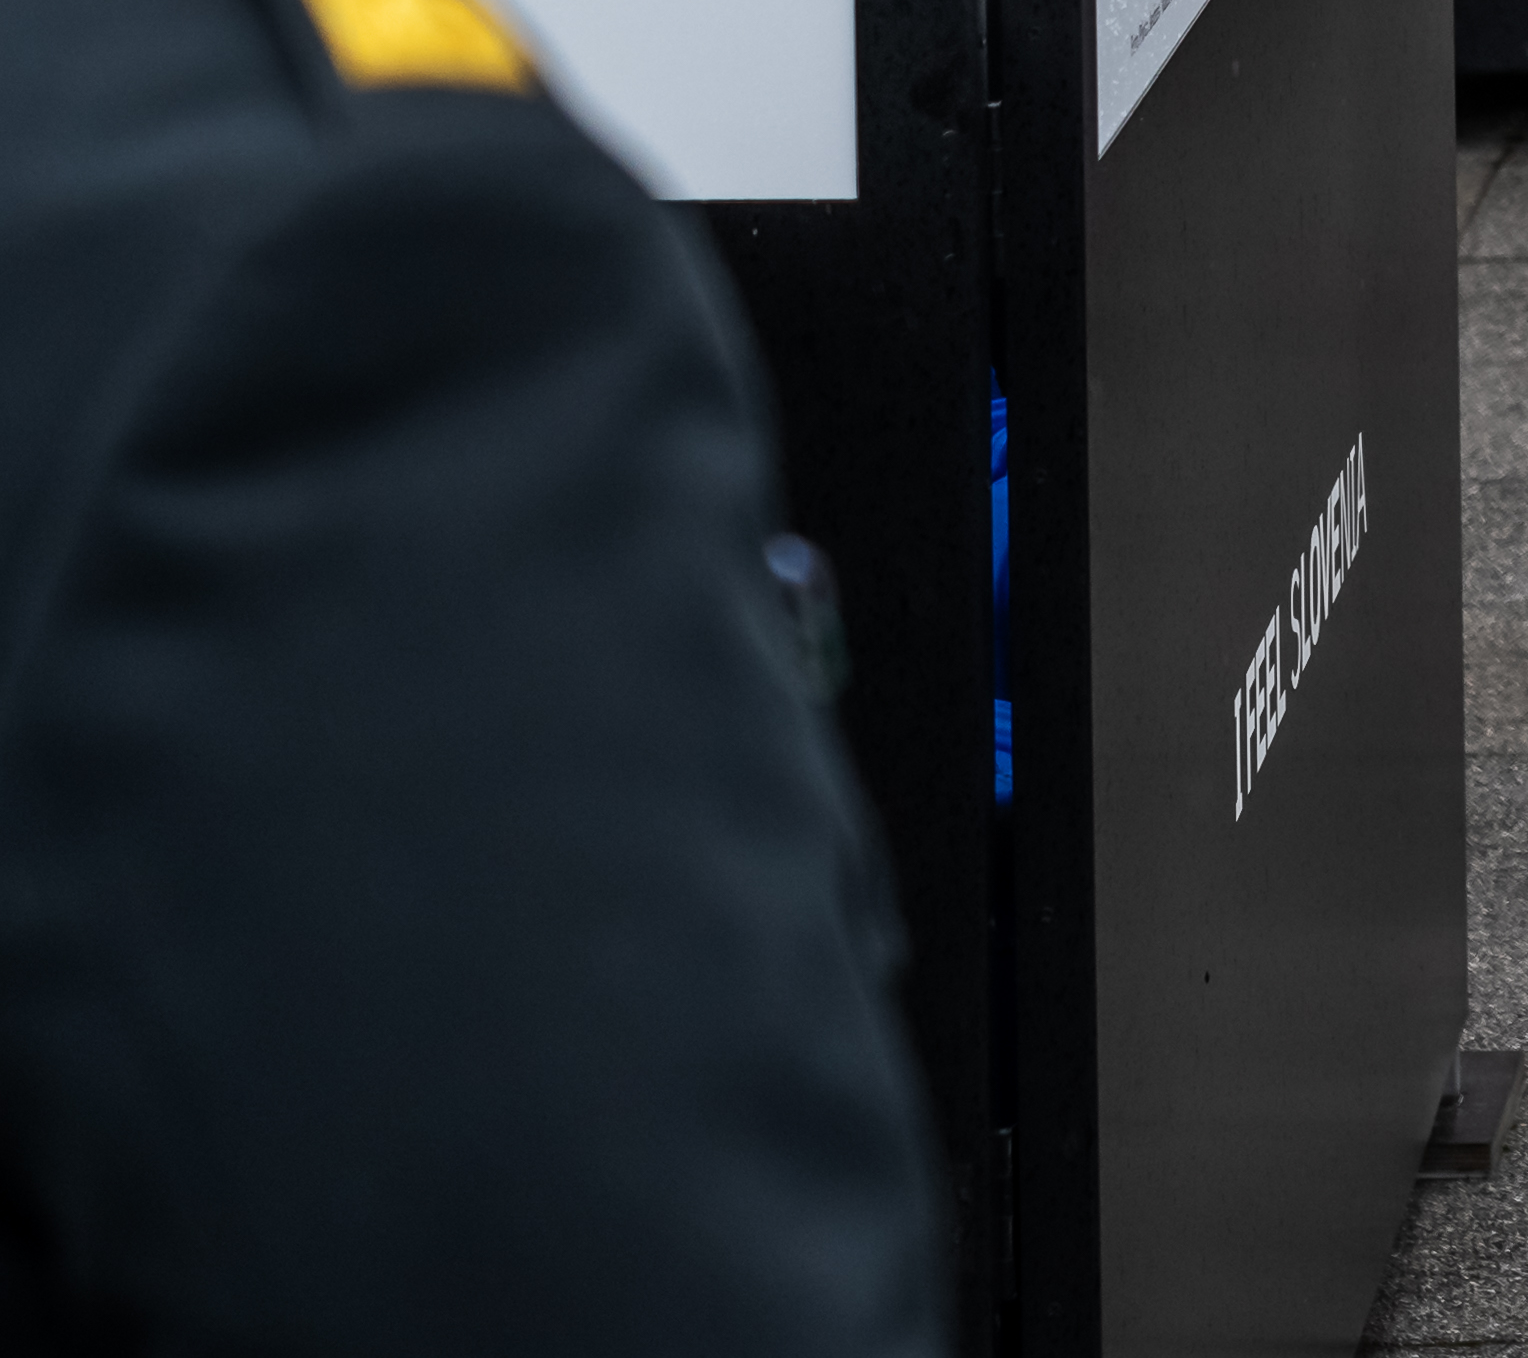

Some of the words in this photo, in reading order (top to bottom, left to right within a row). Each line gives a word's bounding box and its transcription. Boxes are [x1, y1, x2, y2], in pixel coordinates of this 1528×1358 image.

[1234, 687, 1244, 823] I
[1246, 605, 1287, 796] FEEL
[1290, 431, 1368, 690] SLOVENIA
